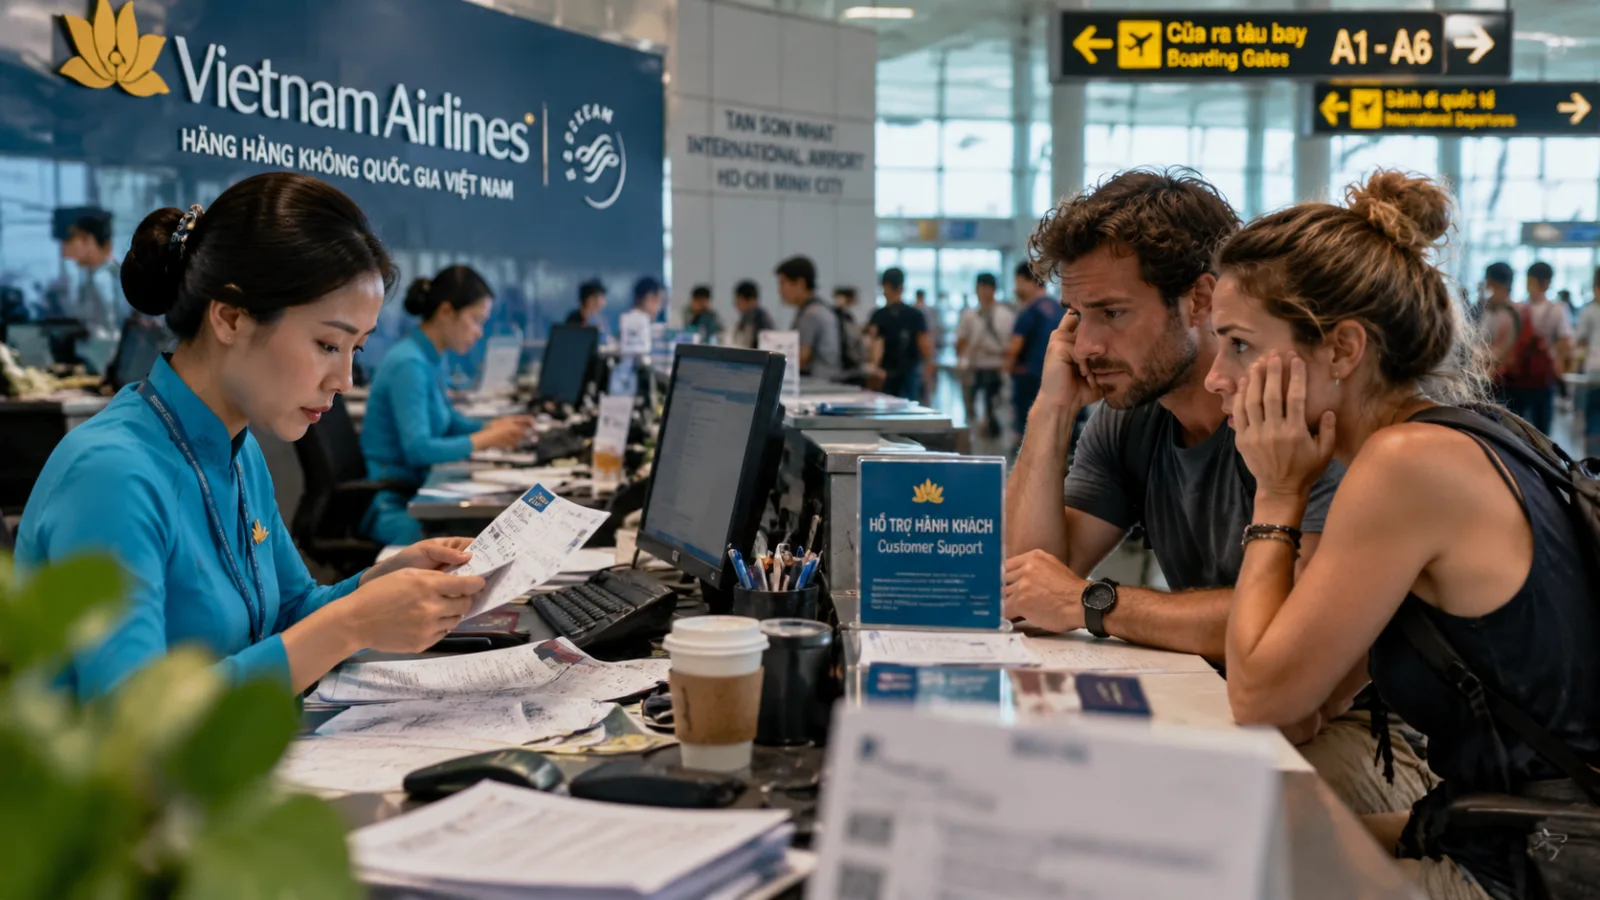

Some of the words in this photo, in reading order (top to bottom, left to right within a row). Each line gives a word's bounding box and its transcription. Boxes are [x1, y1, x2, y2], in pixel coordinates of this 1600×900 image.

[1211, 26, 1232, 44] ra
[1271, 21, 1308, 48] bay
[1330, 28, 1368, 65] A1
[1374, 43, 1388, 54] -
[1389, 28, 1433, 65] A6
[1167, 48, 1239, 72] Boarding
[1242, 48, 1290, 68] Gates
[175, 35, 379, 137] Vietnam
[383, 83, 530, 163] Airlines
[413, 166, 442, 191] GIA
[480, 176, 514, 201] NAM
[877, 539, 934, 554] Customer
[937, 540, 984, 557] Support
